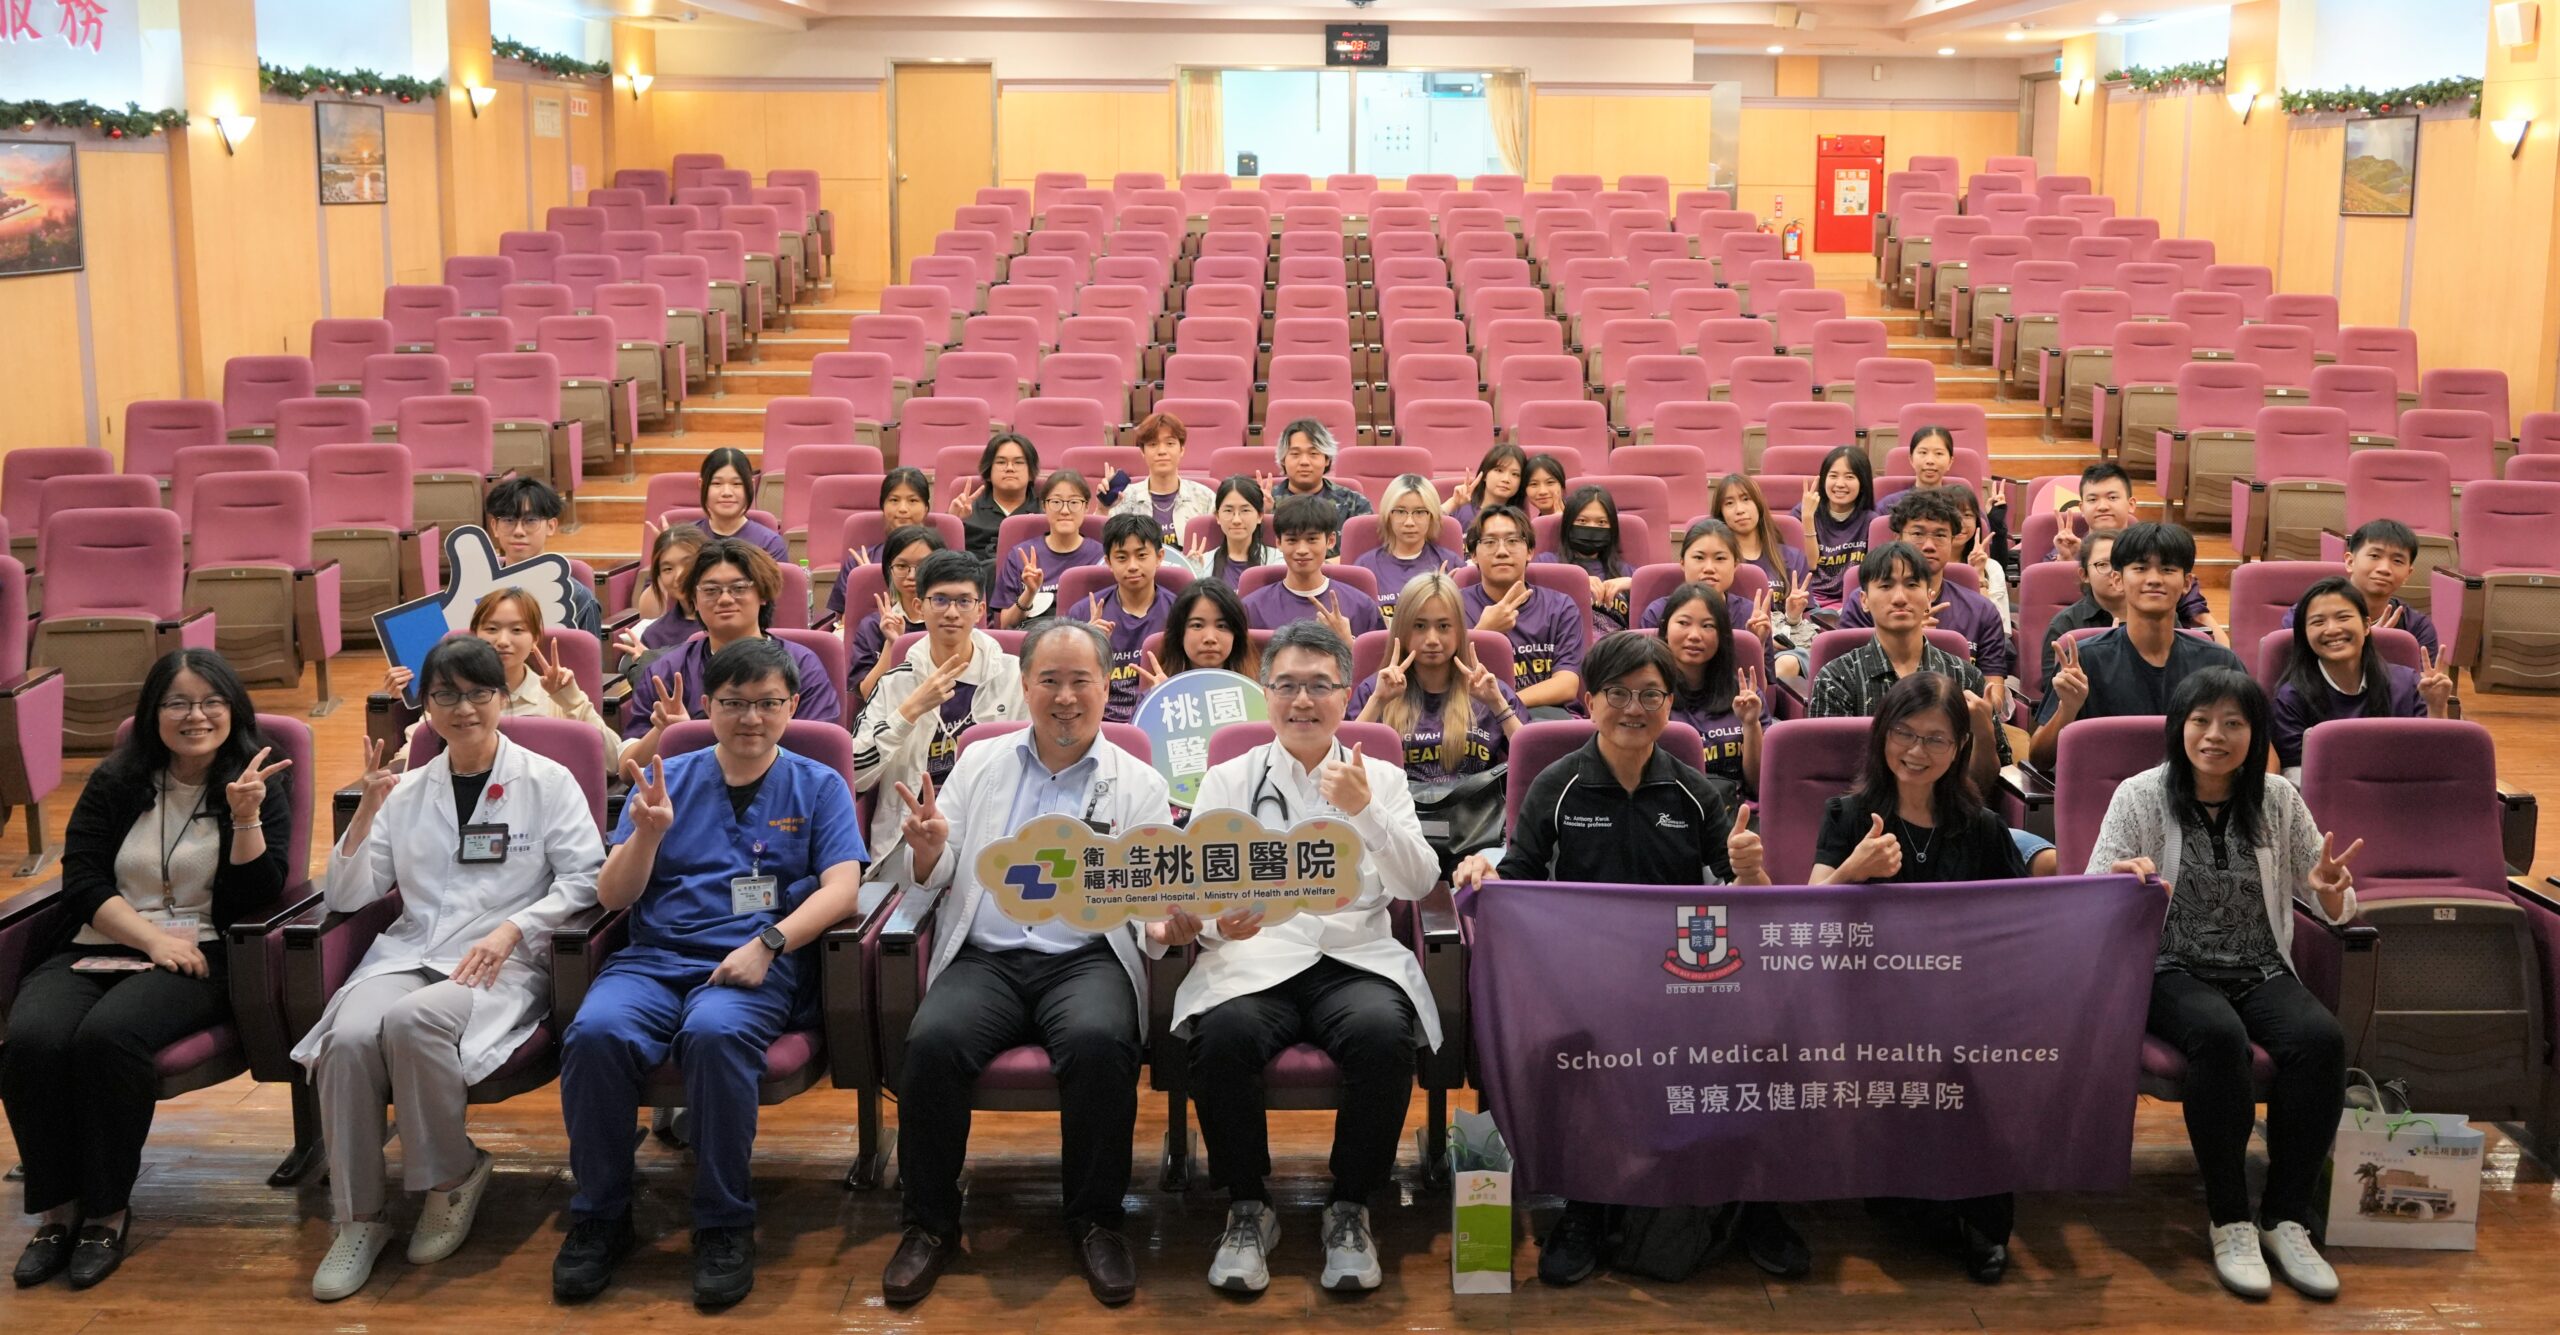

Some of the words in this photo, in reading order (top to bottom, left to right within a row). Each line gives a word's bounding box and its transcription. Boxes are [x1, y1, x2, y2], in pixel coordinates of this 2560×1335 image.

[1377, 593, 1396, 602] UNG
[1161, 687, 1248, 732] 桃園
[1415, 731, 1441, 742] WAH
[1466, 725, 1491, 741] LEGE
[1708, 726, 1745, 739] COLLE
[1166, 735, 1208, 778] 醫
[1154, 839, 1335, 885] 桃園醫院
[1083, 868, 1153, 890] 福利部
[1085, 894, 1123, 905] Taoyuan
[1125, 893, 1158, 903] General
[1204, 891, 1239, 900] Ministry
[1241, 889, 1251, 899] of
[1253, 887, 1281, 898] Health
[1284, 887, 1300, 897] and
[1302, 887, 1336, 896] Welfare
[1759, 922, 1874, 948] 東華學院
[1760, 955, 1814, 971] TUNG
[1821, 955, 1866, 970] WAH
[1873, 955, 1963, 971] COLLEGE
[1556, 1048, 1643, 1070] School
[1652, 1046, 1678, 1066] of
[1689, 1044, 1788, 1064] Medical
[1798, 1043, 1846, 1062] and
[1857, 1043, 1942, 1062] Health
[1953, 1045, 2060, 1064] Sciences
[1665, 1080, 1965, 1115] 醫療及健康科學學院
